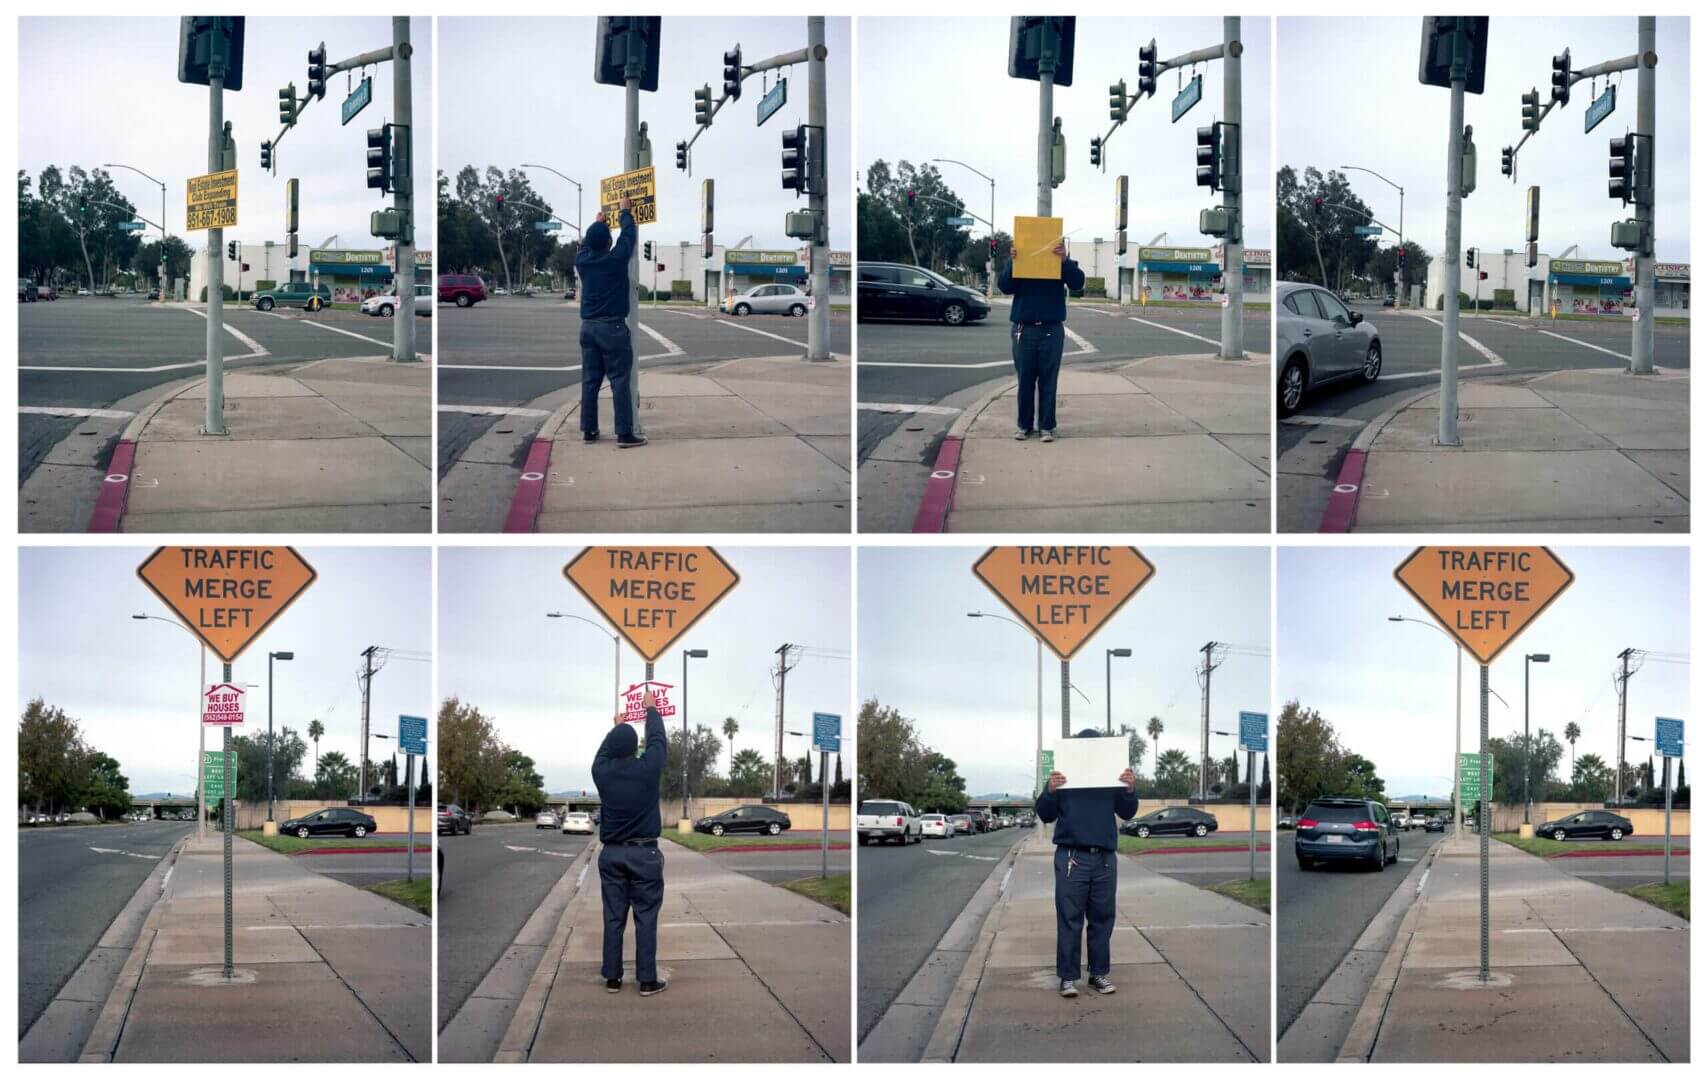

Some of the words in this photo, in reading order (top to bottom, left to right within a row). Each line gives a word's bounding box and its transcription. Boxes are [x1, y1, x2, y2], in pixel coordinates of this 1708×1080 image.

[627, 172, 651, 188] Investment
[607, 189, 618, 202] Club
[188, 207, 235, 228] 951-667-1908
[1174, 250, 1208, 259] DENTISTRY
[1585, 262, 1619, 273] DENTISTRY
[181, 548, 274, 570] TRAFFIC
[607, 549, 699, 573] TRAFFIC
[1016, 546, 1112, 566] TRAFFIC
[1438, 550, 1531, 572] TRAFFIC
[185, 578, 273, 599] MERGE
[610, 578, 697, 601] MERGE
[1021, 575, 1110, 595] MERGE
[1442, 580, 1530, 601] MERGE
[200, 607, 254, 628] LEFT
[624, 607, 677, 629] LEFT
[1036, 604, 1091, 625] LEFT
[1456, 609, 1511, 630] LEFT
[208, 695, 220, 703] WE
[222, 693, 239, 703] BUY
[626, 692, 643, 702] WE
[653, 687, 668, 698] UY
[626, 697, 669, 711] HOES
[207, 702, 240, 712] HOUSES
